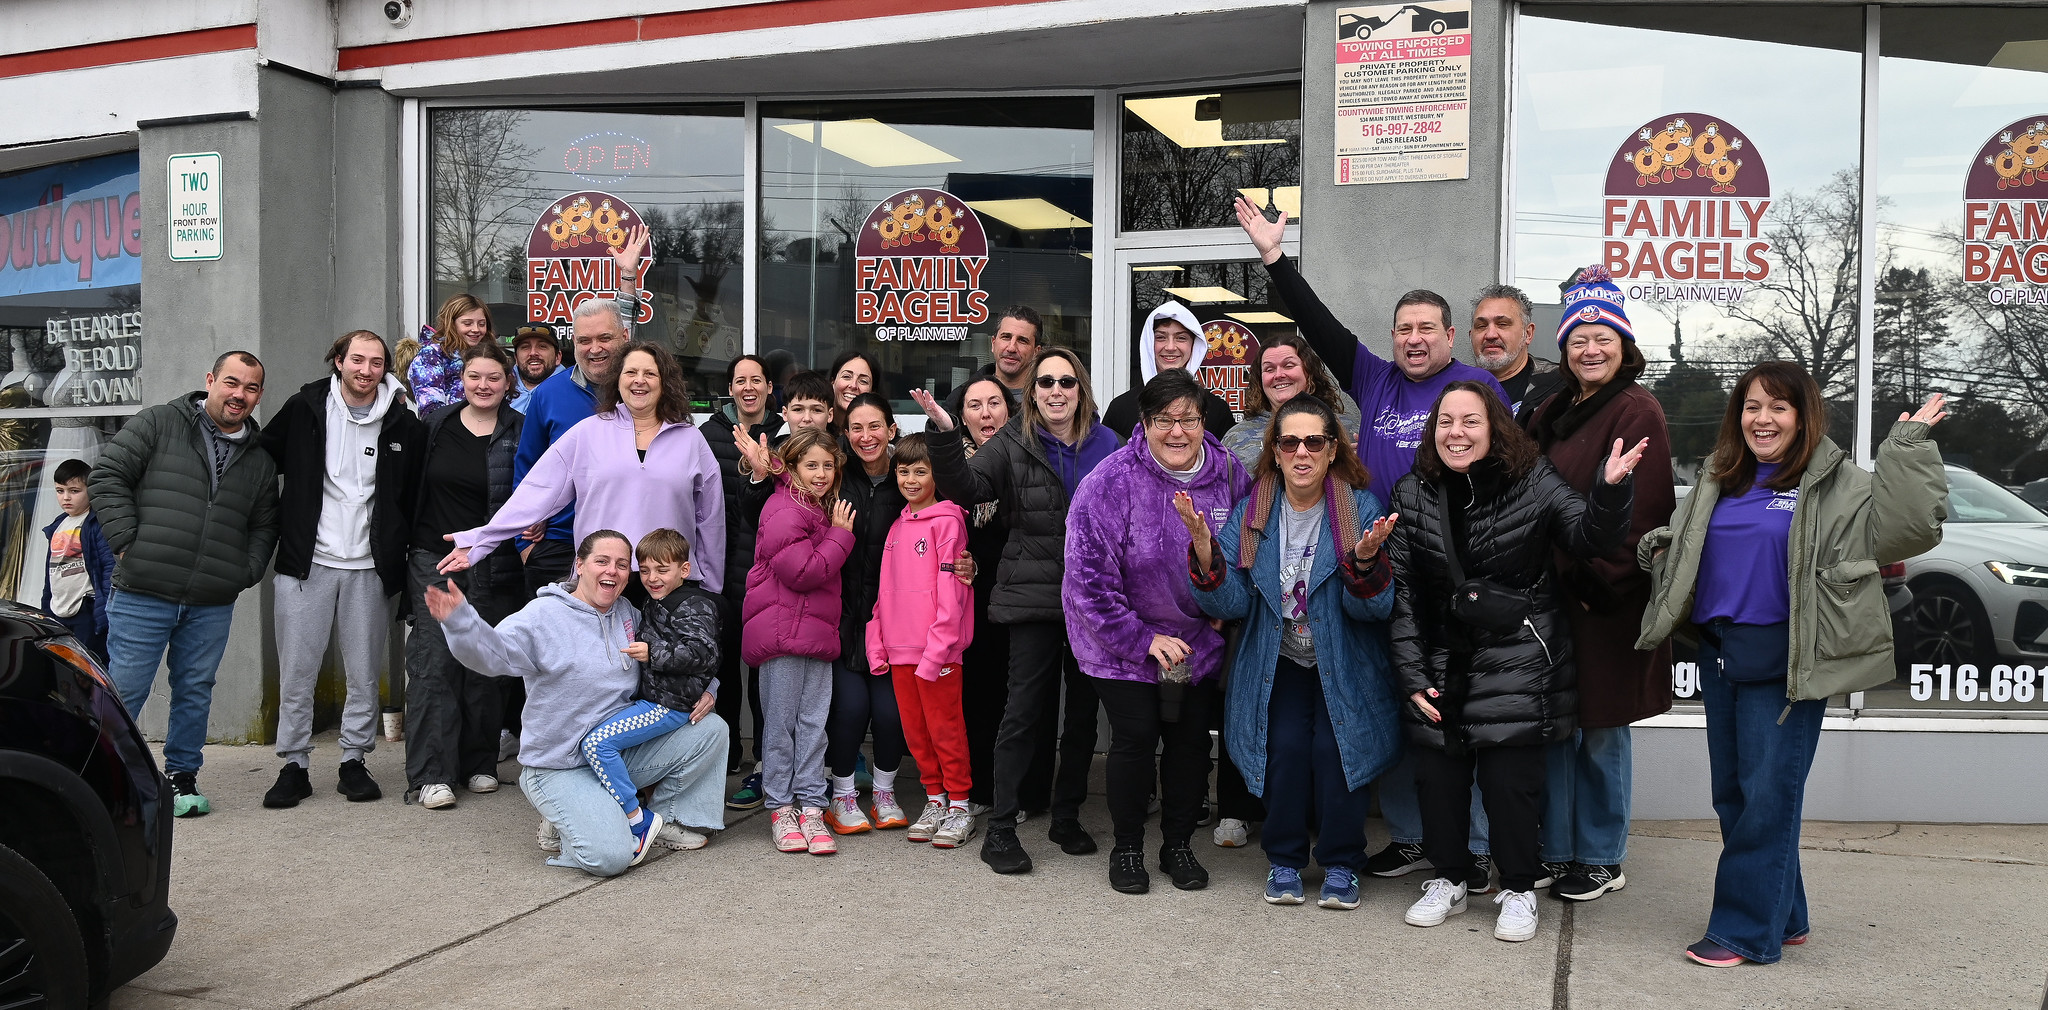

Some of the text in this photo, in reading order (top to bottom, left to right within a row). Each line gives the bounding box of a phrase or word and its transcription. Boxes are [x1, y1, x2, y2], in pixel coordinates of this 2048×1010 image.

[1342, 36, 1464, 52] TOWING ENFORCED
[1360, 47, 1446, 60] AT ALL TIMES
[1399, 60, 1446, 68] PROPERTY
[1344, 69, 1394, 78] CUSTOMER
[1338, 103, 1467, 116] COUNTYWIDE TOWING ENFORCEMENT
[1362, 120, 1442, 137] 516-997-2842
[564, 144, 650, 171] OPEN
[181, 172, 208, 192] TWO
[183, 203, 207, 216] HOUR
[200, 218, 218, 226] ROW
[1603, 199, 1771, 238] FAMILY
[177, 228, 214, 242] PARKING
[1603, 241, 1770, 281] BAGELS
[856, 257, 989, 290] FAMILY
[1629, 286, 1743, 300] OF PLAINVIEW
[1990, 288, 2014, 304] OF
[856, 290, 989, 325] BAGELS
[47, 318, 68, 344] BE
[876, 326, 968, 341] OF PLAINVIEW
[70, 345, 138, 372] BE BOLD
[1910, 664, 2048, 702] 516.681
